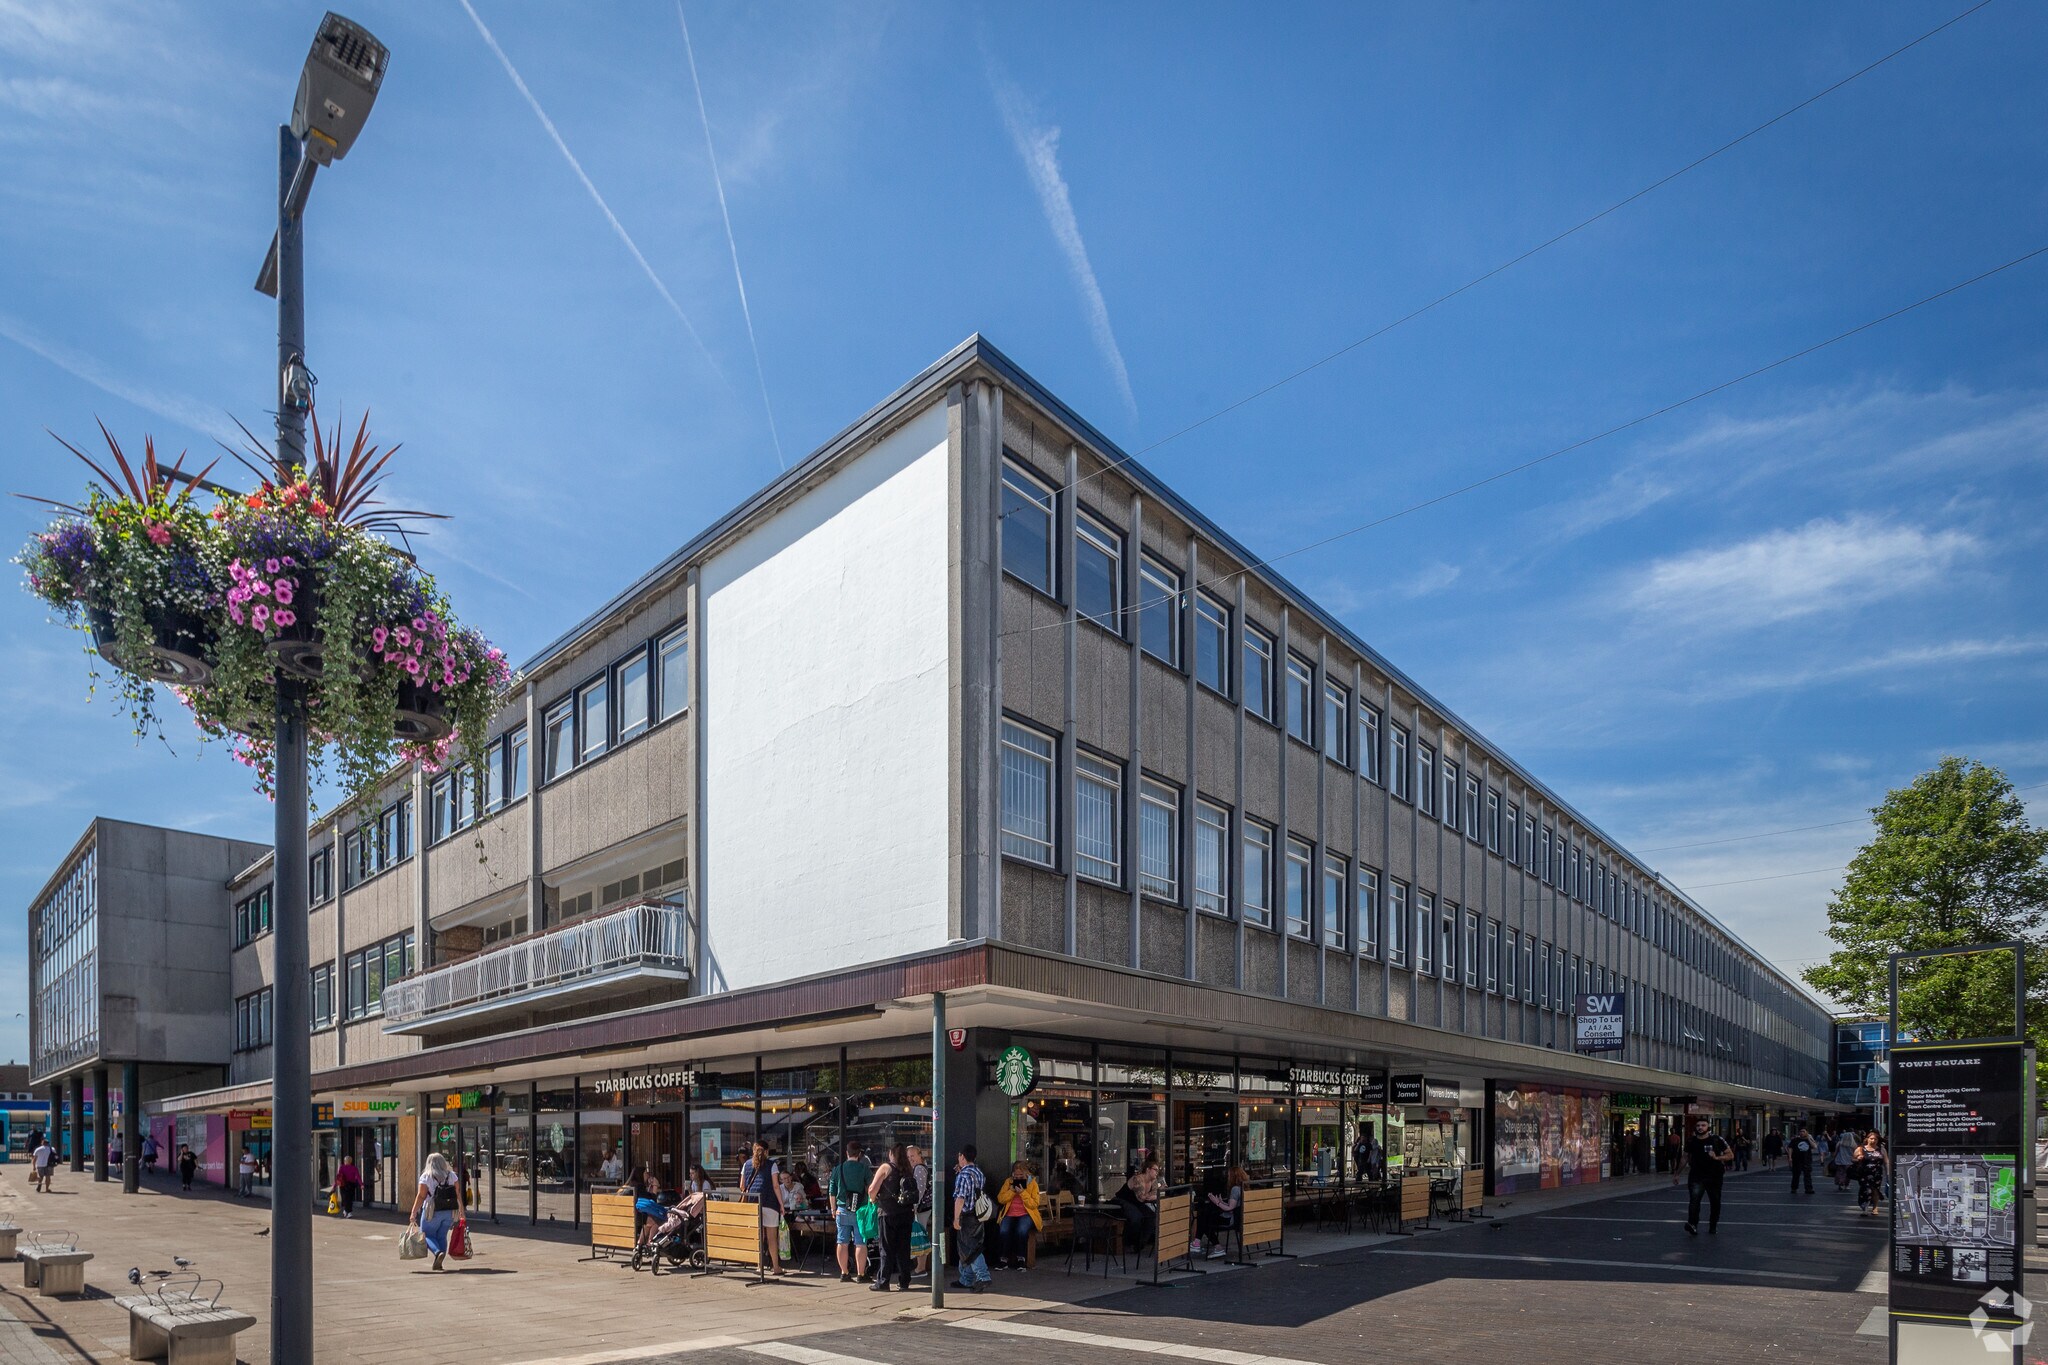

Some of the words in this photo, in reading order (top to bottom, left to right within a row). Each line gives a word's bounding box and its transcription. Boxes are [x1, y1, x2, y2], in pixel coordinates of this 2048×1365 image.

[1586, 995, 1615, 1013] SW
[1578, 1016, 1597, 1024] Shop
[1899, 1060, 1933, 1068] TOWN
[1935, 1058, 1981, 1066] SQUARE
[595, 1074, 653, 1094] STARBUCKS
[654, 1070, 695, 1088] COFFEE
[1289, 1067, 1340, 1085] STARBUCKS
[1341, 1072, 1369, 1086] COFFEE
[446, 1090, 481, 1110] SUBWAY
[1428, 1088, 1444, 1098] Warren
[1444, 1089, 1459, 1099] James
[342, 1101, 400, 1111] SUBWAY
[1504, 1119, 1532, 1136] Stevenage
[1532, 1120, 1538, 1134] is
